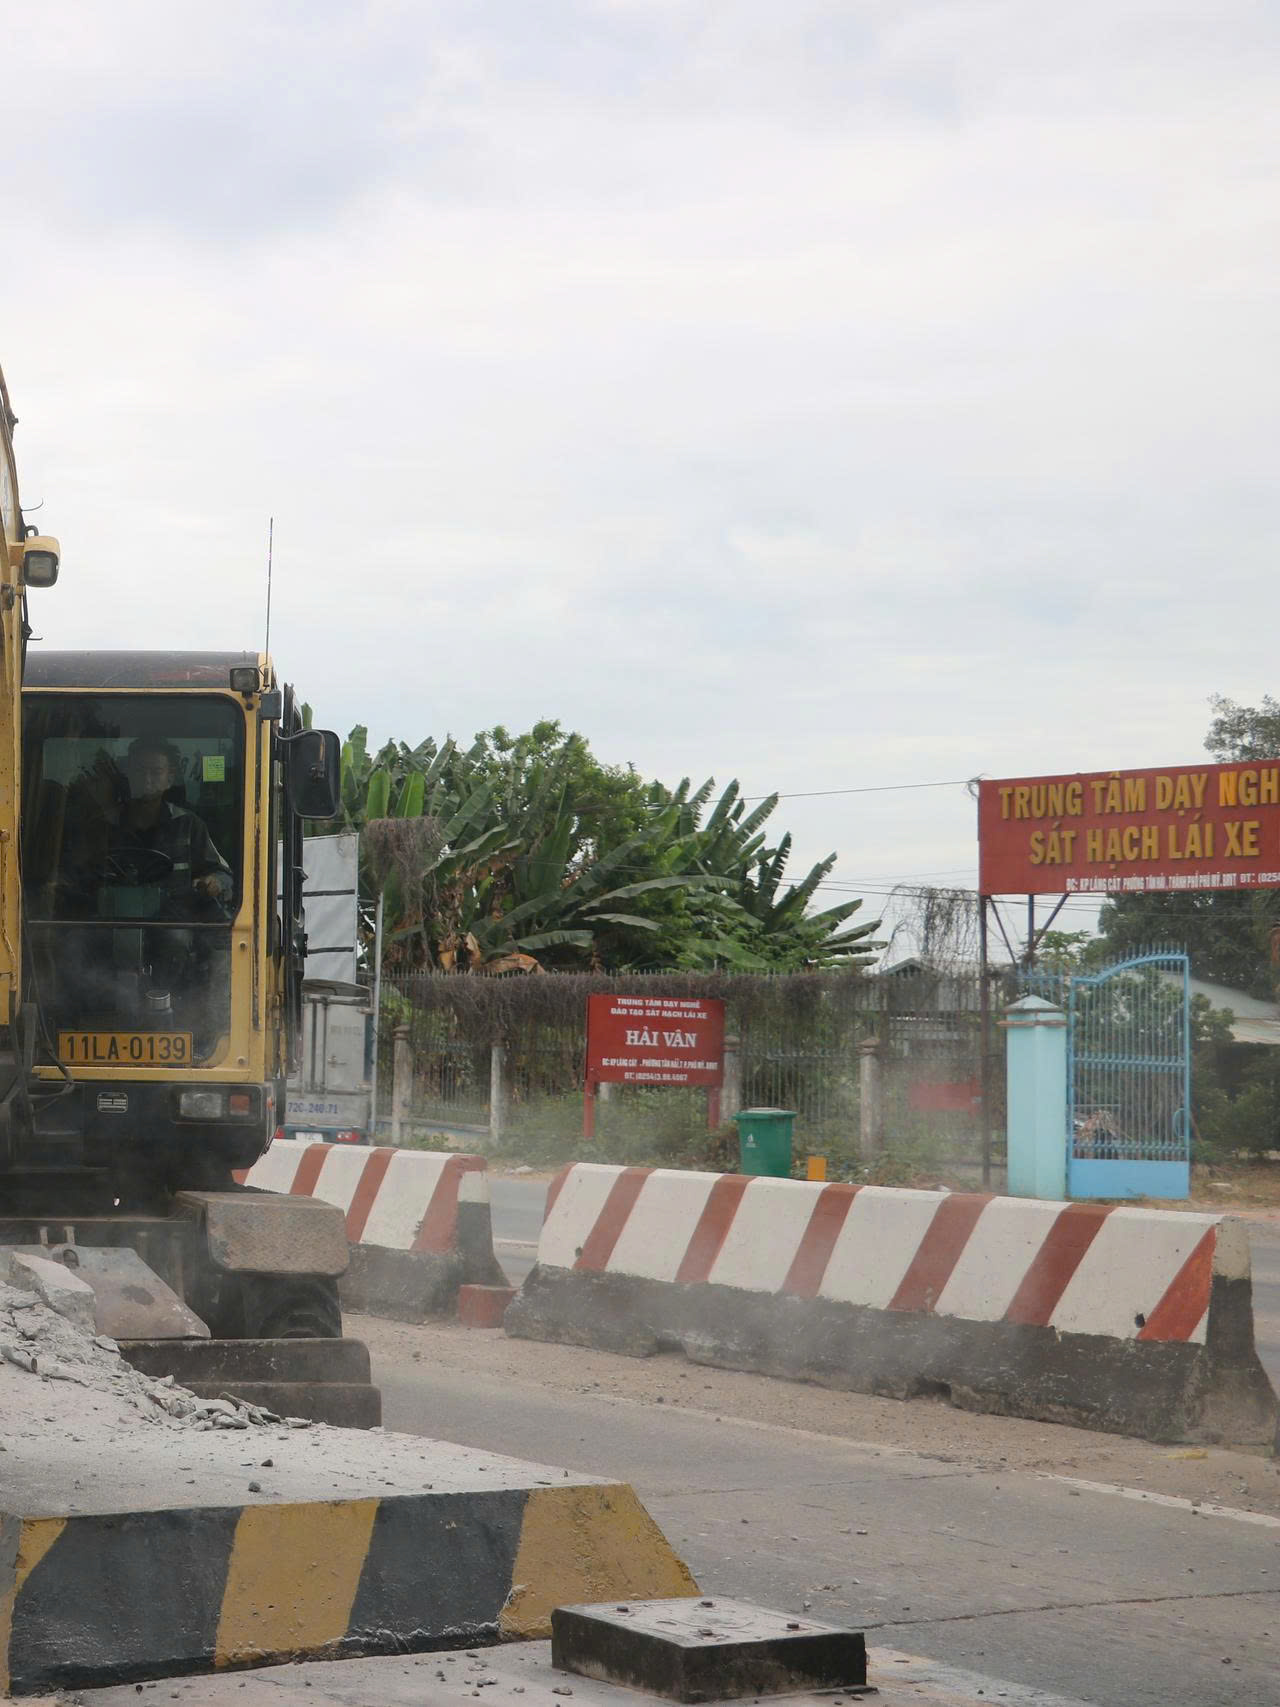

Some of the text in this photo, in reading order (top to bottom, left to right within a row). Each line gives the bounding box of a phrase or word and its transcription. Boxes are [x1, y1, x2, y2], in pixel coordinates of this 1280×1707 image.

[998, 781, 1083, 820] TRUNG
[1090, 771, 1147, 815] TÂM
[1155, 773, 1208, 816] DẠY
[1029, 812, 1261, 870] SÁT HẠCH LÁI XE
[617, 998, 643, 1006] TRUNG
[645, 998, 662, 1007] TÂM
[67, 1035, 186, 1060] 11LA-0139
[625, 1025, 697, 1048] HẢI VÂN
